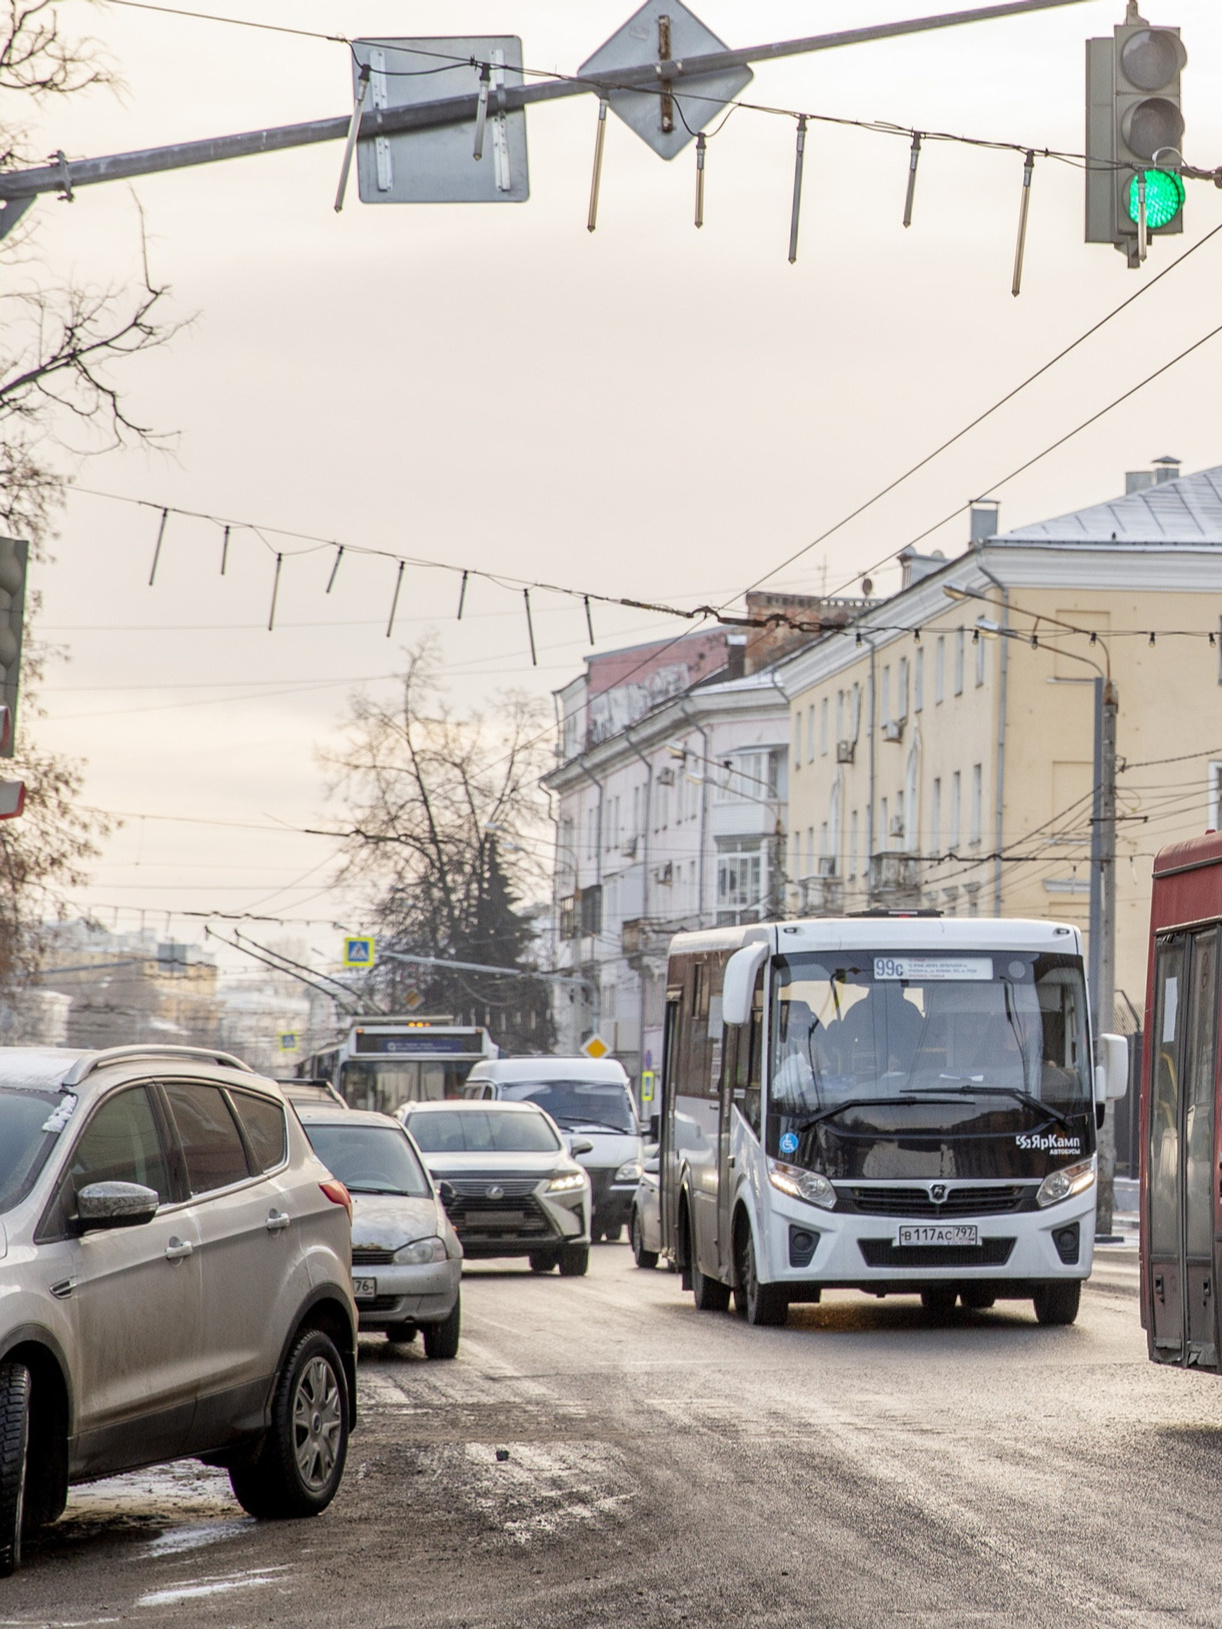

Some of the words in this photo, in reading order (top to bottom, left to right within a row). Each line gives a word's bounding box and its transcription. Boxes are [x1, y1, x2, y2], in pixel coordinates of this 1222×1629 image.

[1032, 1134, 1080, 1150] ЯрКамп
[955, 1227, 973, 1237] 797
[355, 1281, 369, 1291] 76
